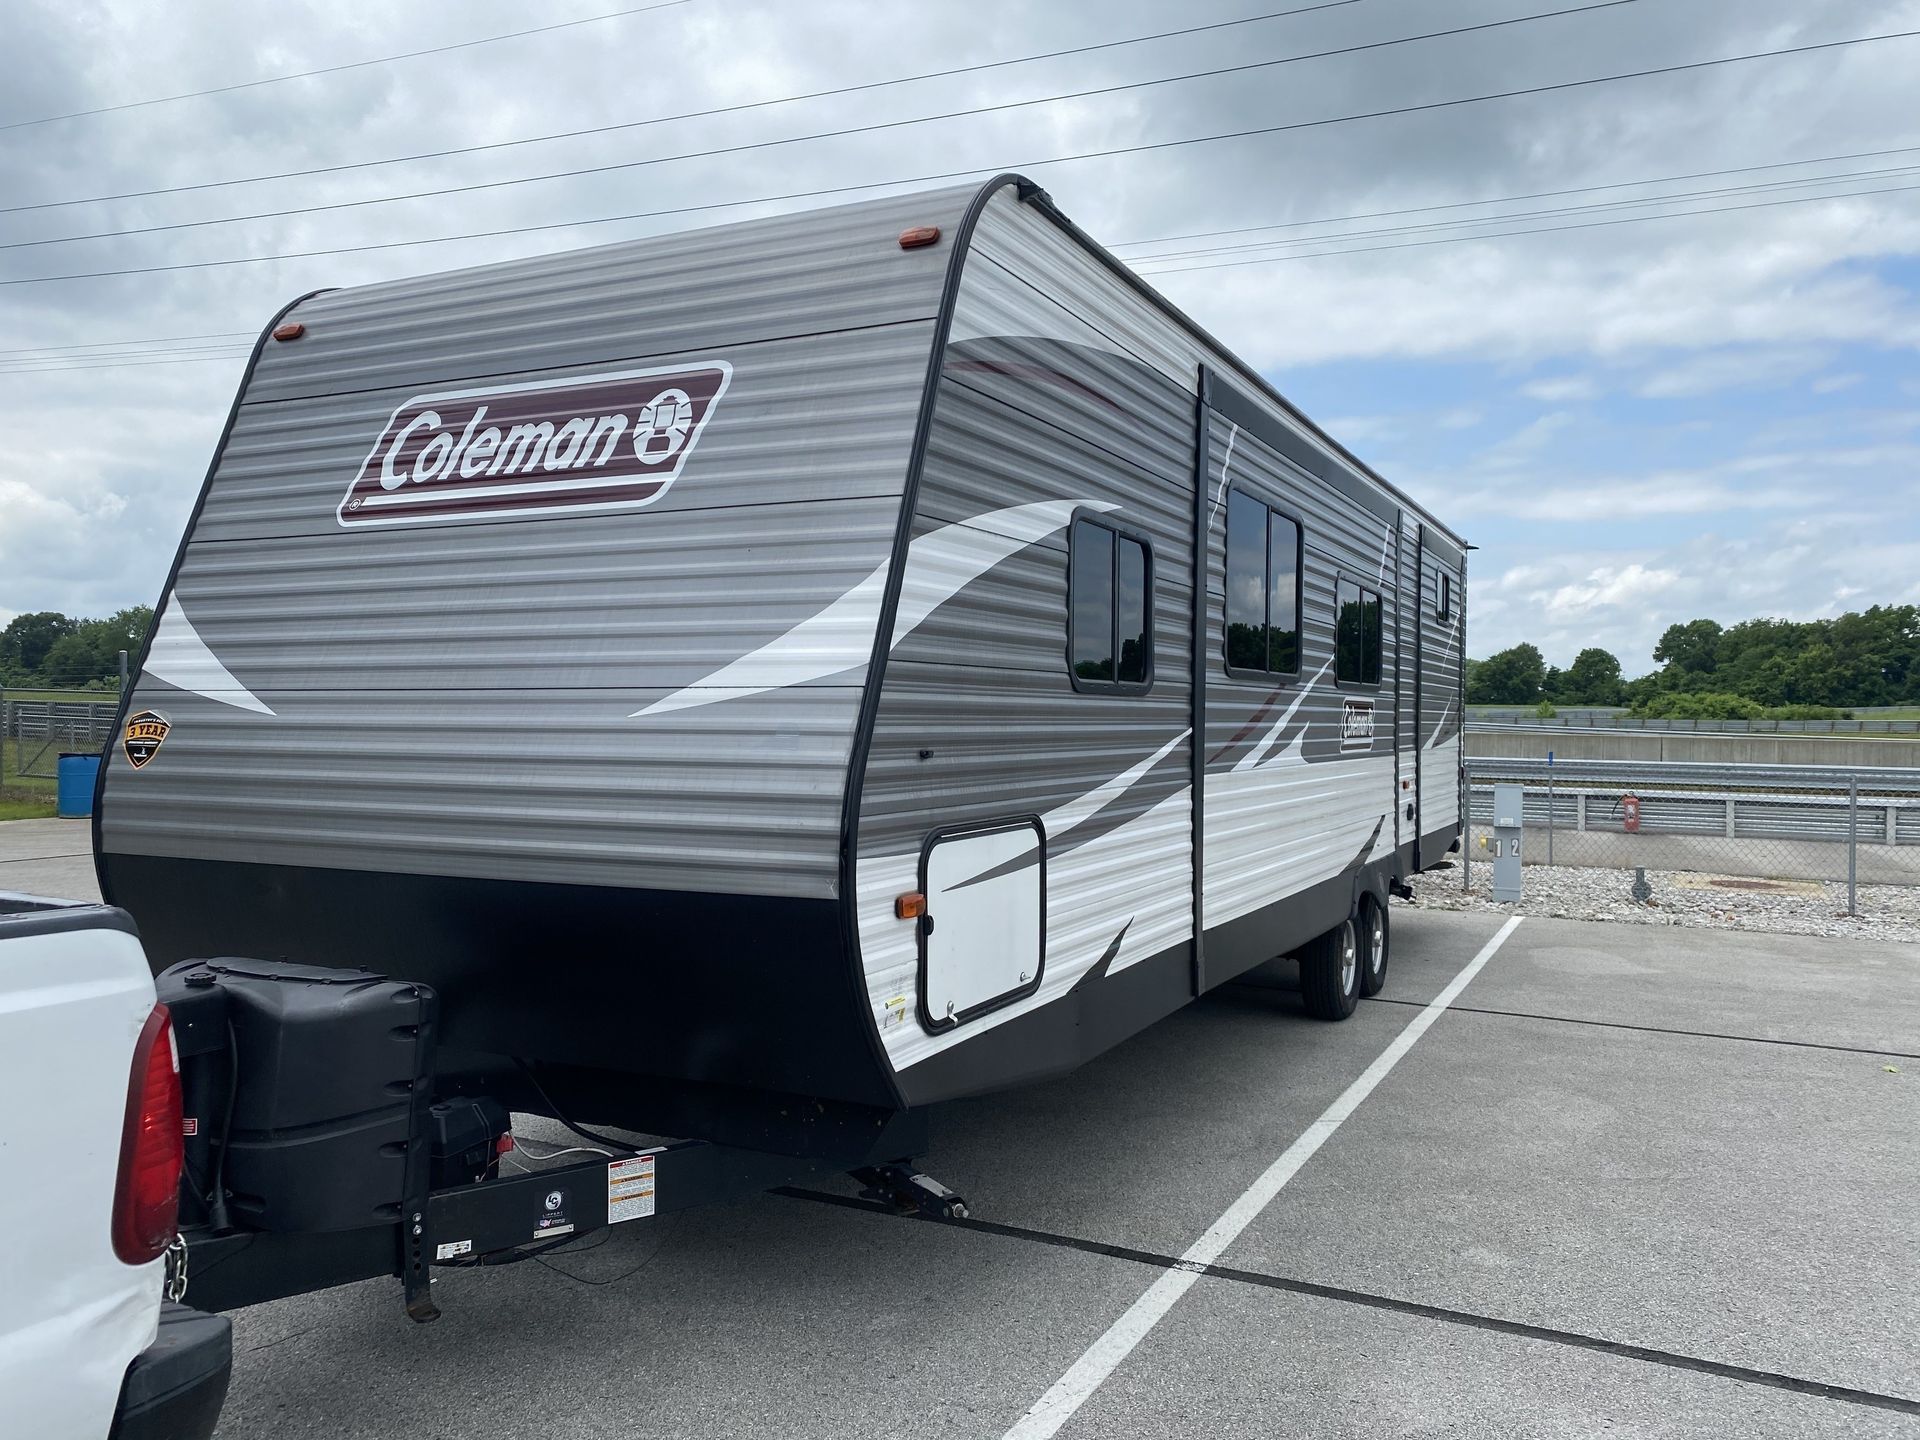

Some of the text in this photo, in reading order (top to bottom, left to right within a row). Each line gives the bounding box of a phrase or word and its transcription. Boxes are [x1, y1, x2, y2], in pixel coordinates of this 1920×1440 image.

[380, 406, 628, 491] Coleman
[129, 725, 167, 738] 3 YEAR
[1496, 839, 1519, 857] 1 2
